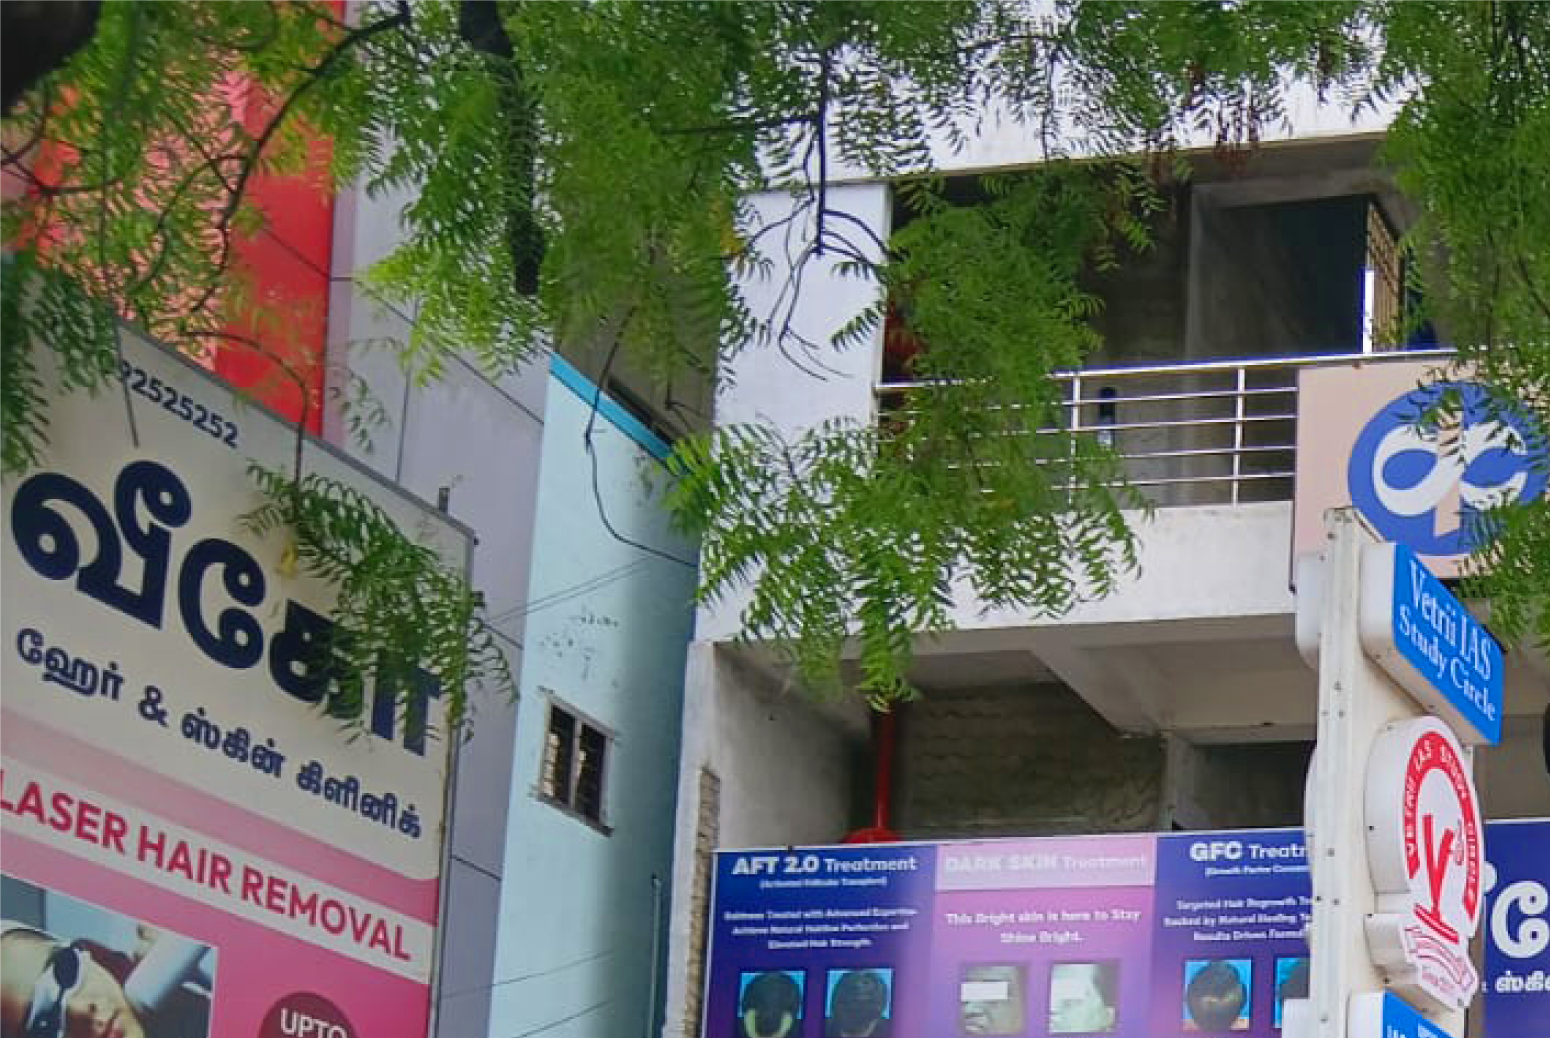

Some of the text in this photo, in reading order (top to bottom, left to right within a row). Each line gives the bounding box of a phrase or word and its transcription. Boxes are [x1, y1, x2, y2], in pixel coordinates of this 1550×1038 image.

[1399, 603, 1497, 722] Study Circle
[1460, 615, 1491, 682] IAS
[138, 685, 169, 728] &
[181, 707, 286, 778] ஸ்கின்
[296, 761, 422, 839] கிளினிக்
[0, 769, 412, 963] LASER HAIR REMOVAL
[731, 854, 918, 876] AFT 2.0 Treatment
[944, 855, 1001, 872] DARK
[1008, 853, 1058, 870] SKIN
[1190, 841, 1308, 862] GFC Treat
